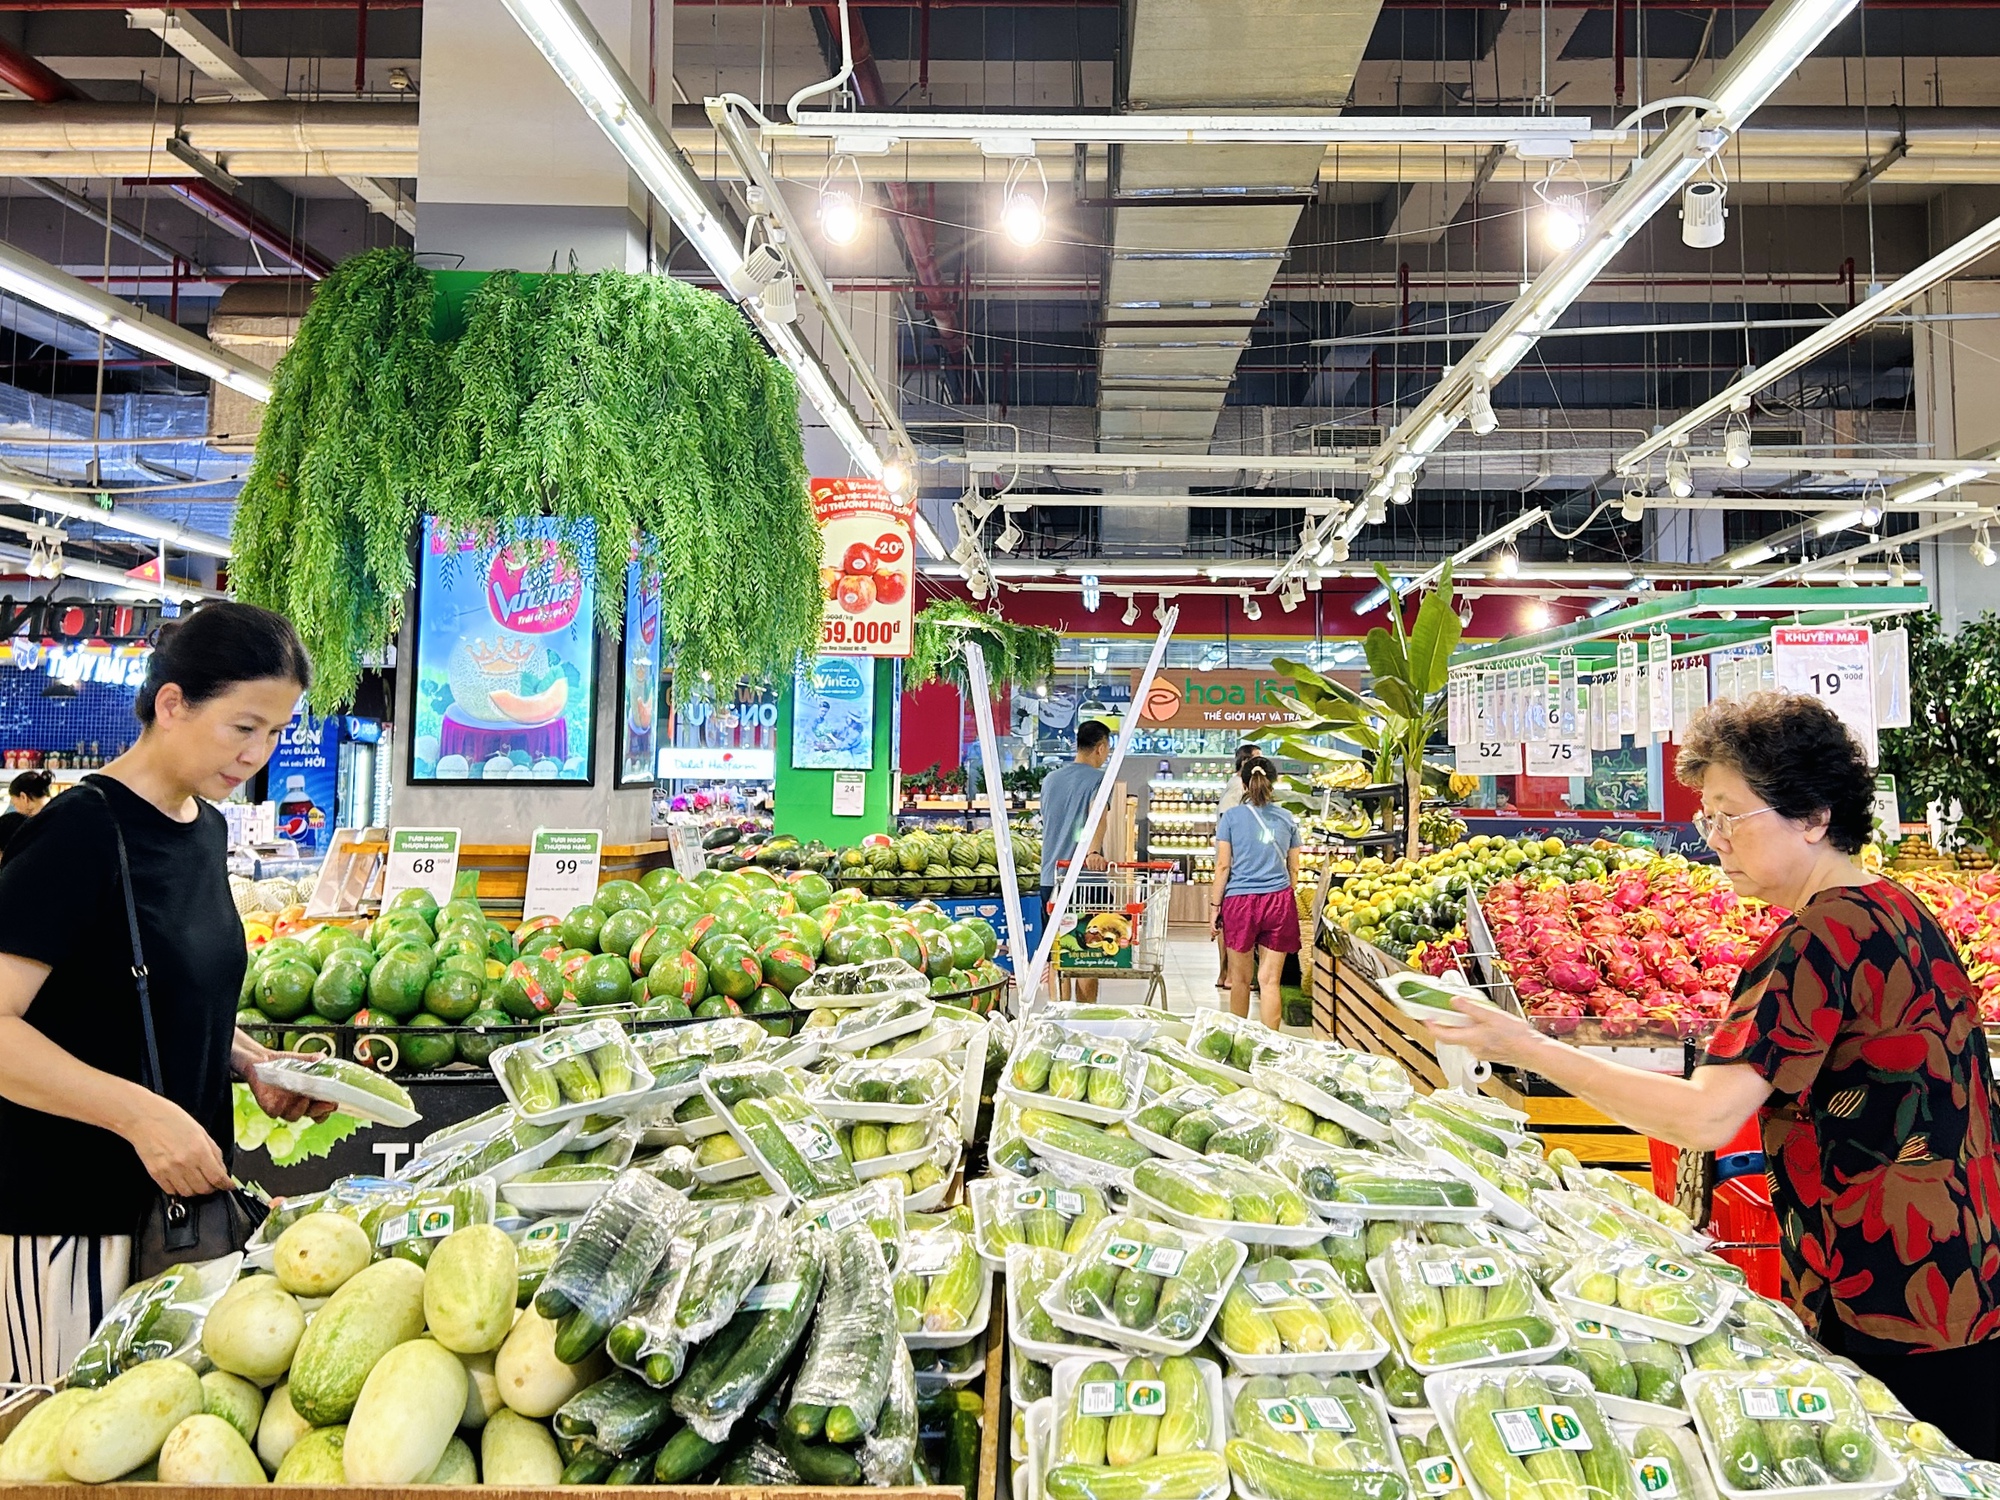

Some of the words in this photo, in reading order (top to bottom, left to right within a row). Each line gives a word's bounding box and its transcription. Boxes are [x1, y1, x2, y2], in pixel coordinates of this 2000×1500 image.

[829, 501, 869, 511] THƯƠNG
[1836, 632, 1860, 645] MẠI
[812, 673, 860, 689] WinEco
[1810, 673, 1842, 695] 19
[1185, 678, 1244, 705] hoa
[1204, 709, 1222, 721] THẾ
[1224, 711, 1246, 721] GIỚI
[1247, 712, 1266, 723] HẠT
[1480, 742, 1502, 757] 52
[1549, 744, 1572, 759] 75
[412, 858, 435, 873] 68
[555, 859, 577, 875] 99
